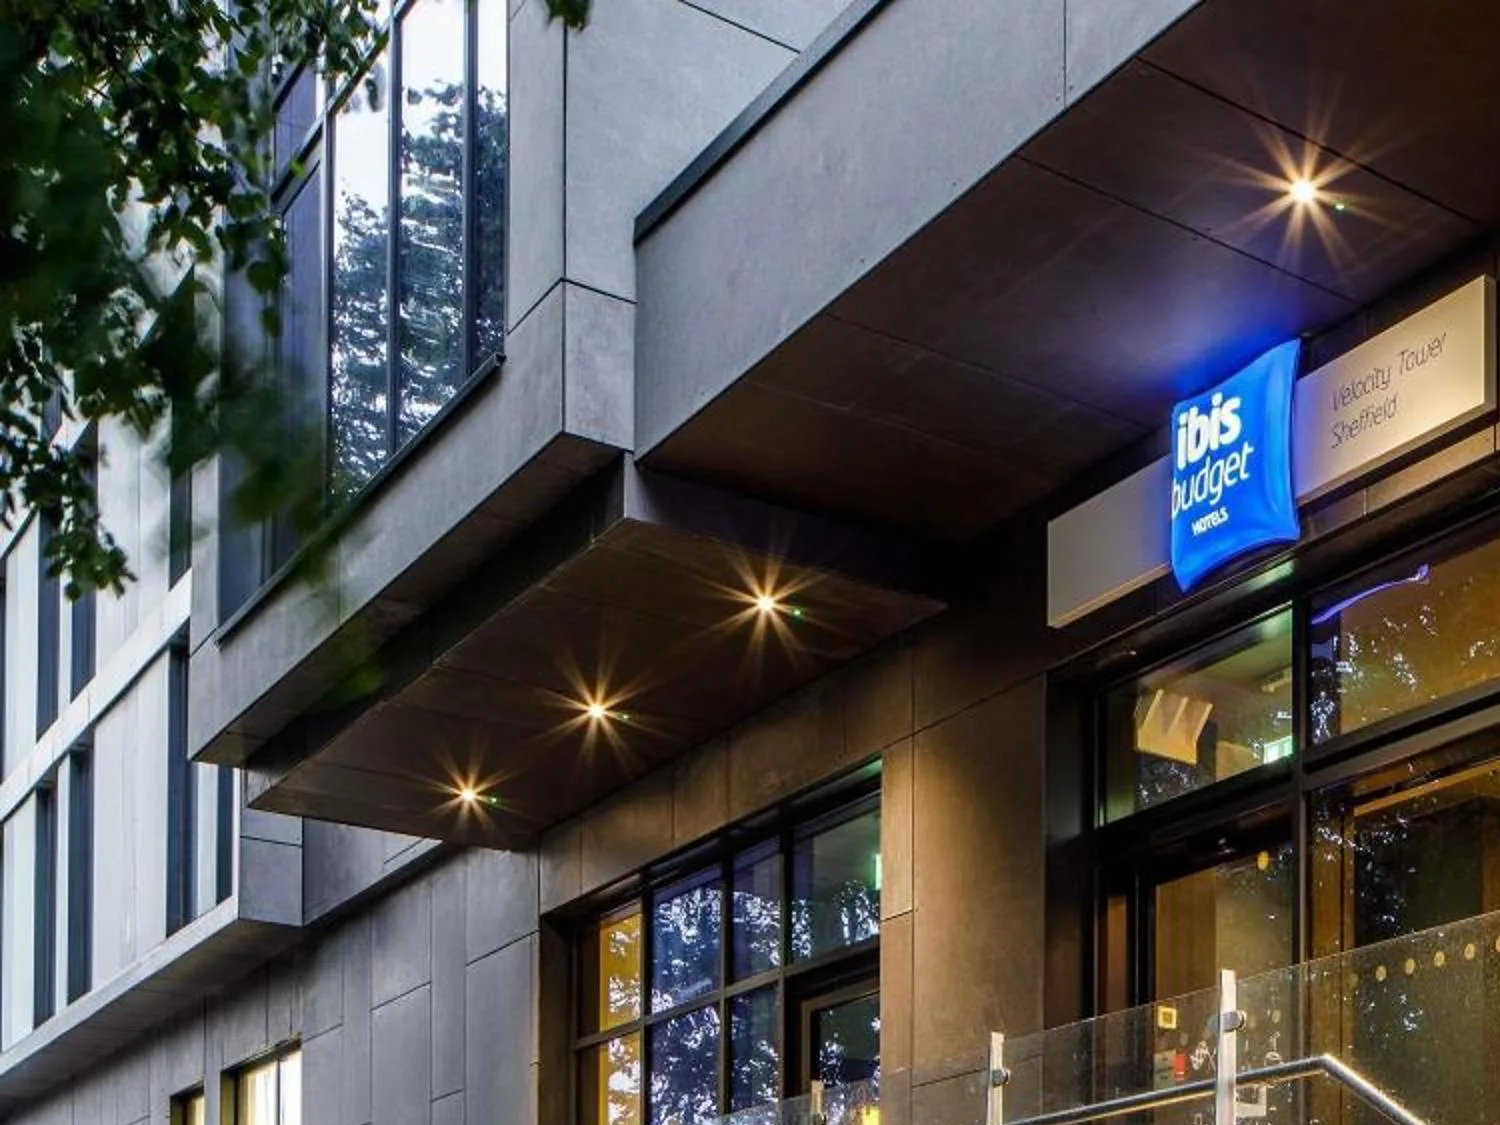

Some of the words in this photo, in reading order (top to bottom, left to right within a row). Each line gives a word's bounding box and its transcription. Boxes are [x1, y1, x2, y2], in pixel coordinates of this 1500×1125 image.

[1331, 365, 1390, 412] Velocity
[1398, 331, 1447, 375] Tower
[1177, 392, 1242, 470] ibis
[1331, 395, 1399, 448] Sheffield
[1171, 440, 1254, 520] budget
